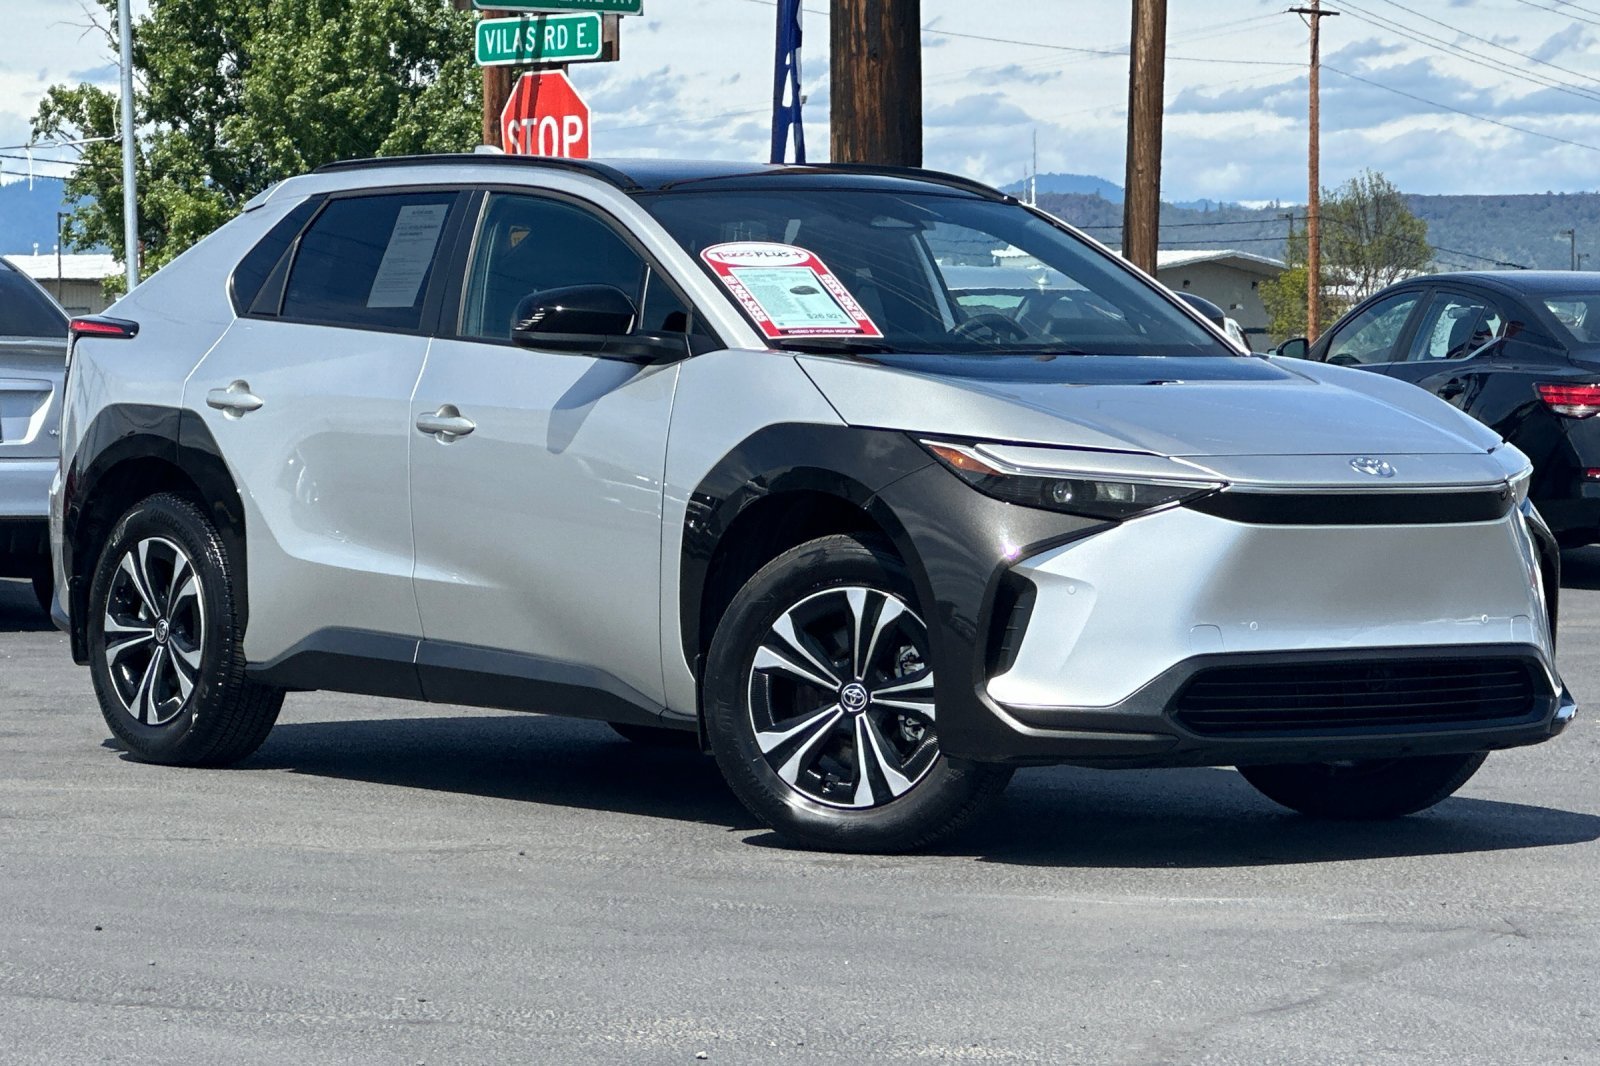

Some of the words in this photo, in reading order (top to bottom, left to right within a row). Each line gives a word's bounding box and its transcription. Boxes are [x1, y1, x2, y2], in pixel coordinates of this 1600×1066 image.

[484, 26, 536, 55] VILAS
[544, 24, 569, 50] RD
[576, 22, 593, 48] E.
[507, 115, 584, 158] STOP
